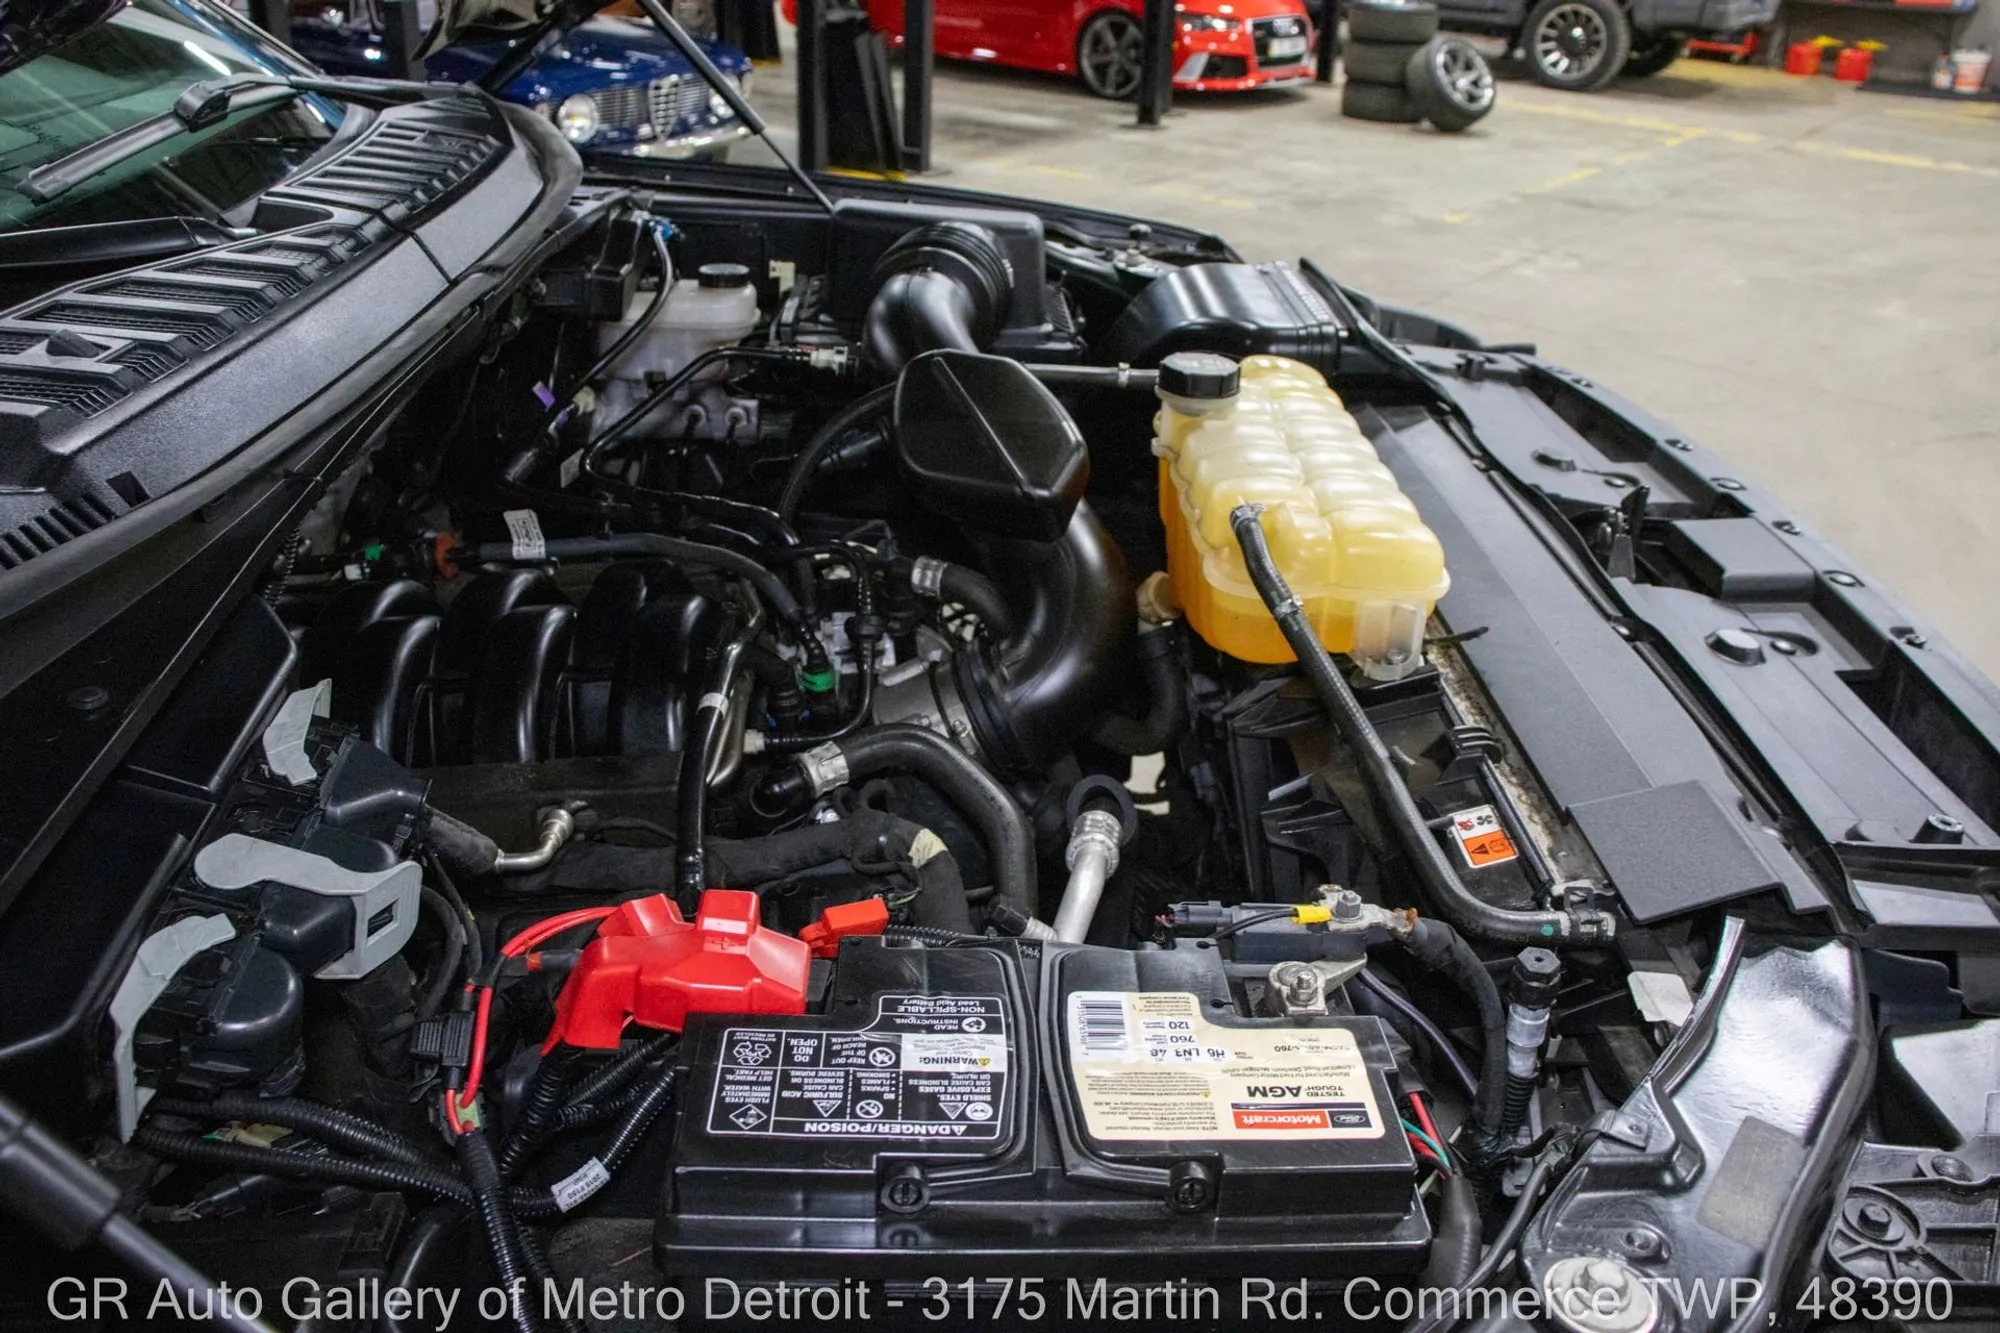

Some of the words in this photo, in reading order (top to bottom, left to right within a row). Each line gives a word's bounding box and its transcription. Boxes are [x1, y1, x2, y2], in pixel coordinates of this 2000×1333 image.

[897, 1005, 985, 1013] NON-SPILLABLE
[1168, 1021, 1189, 1029] 120
[787, 1038, 817, 1046] OPEN.
[792, 1046, 813, 1054] NOT
[1175, 1048, 1200, 1057] LN3
[1207, 1048, 1225, 1058] H6
[919, 1057, 978, 1065] WARNING:
[1246, 1086, 1302, 1098] AGM
[937, 1094, 961, 1102] EYES.
[962, 1094, 991, 1102] SHIELD
[1242, 1114, 1321, 1125] Motorcraft
[804, 1122, 951, 1135] DANGER/POISON
